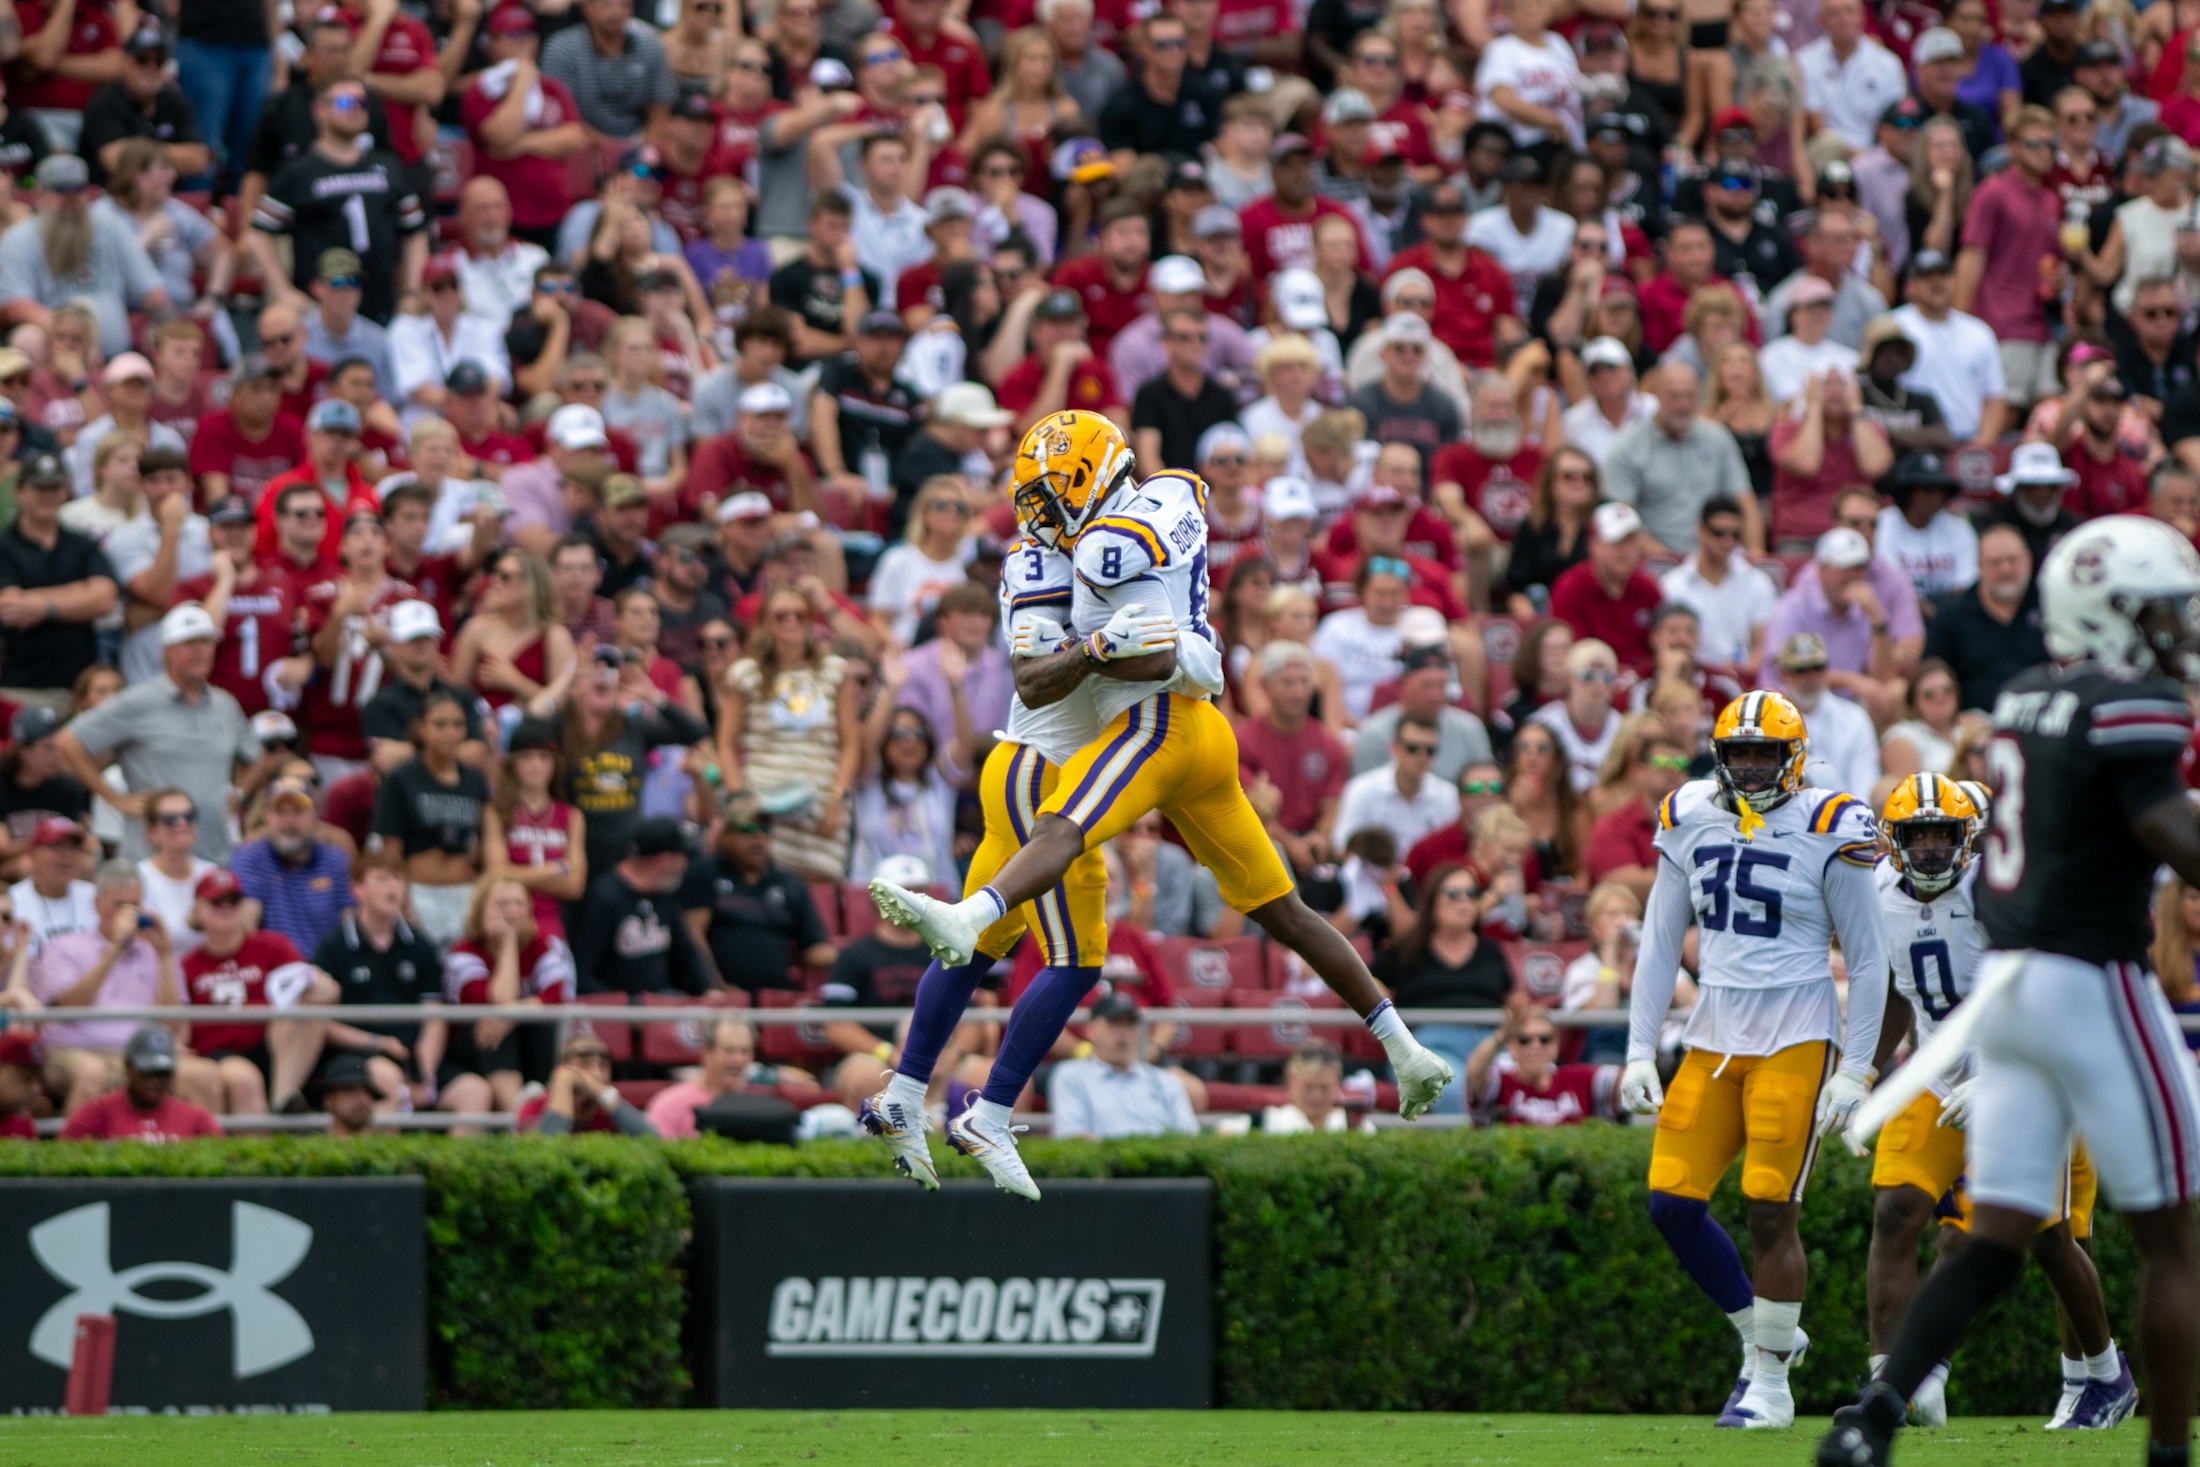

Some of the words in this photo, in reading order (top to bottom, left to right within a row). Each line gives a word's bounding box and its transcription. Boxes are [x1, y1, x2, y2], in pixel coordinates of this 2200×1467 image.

[1024, 550, 1044, 581] 3
[1102, 546, 1122, 579] 8
[237, 614, 259, 680] 1
[1694, 844, 1791, 939] 35
[1918, 929, 1937, 938] LSU
[1910, 939, 1962, 1022] 0
[887, 1102, 908, 1130] NIKE
